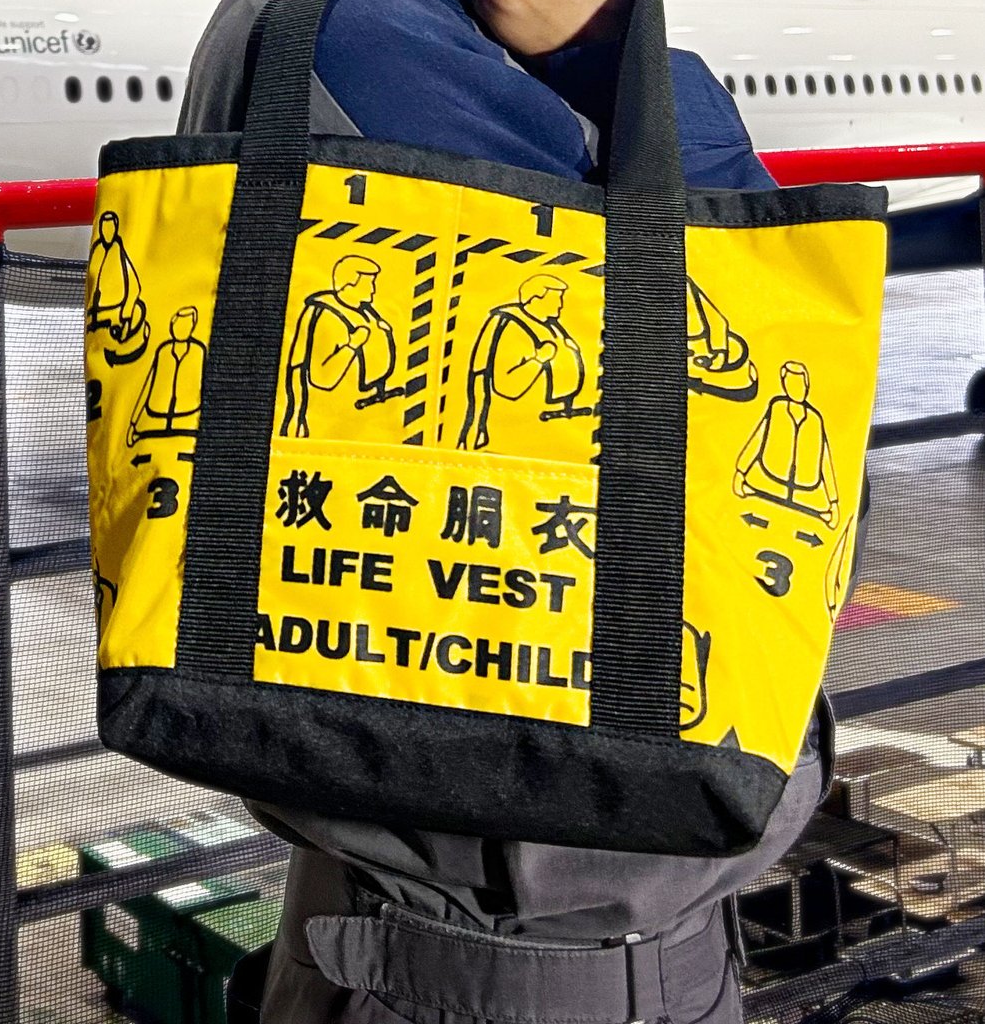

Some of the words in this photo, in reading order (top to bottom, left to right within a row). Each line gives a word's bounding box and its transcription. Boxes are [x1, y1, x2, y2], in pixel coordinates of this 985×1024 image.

[345, 174, 367, 206] 1
[530, 204, 554, 238] 1
[146, 477, 179, 519] 3
[275, 470, 595, 560] 救命胴衣
[281, 545, 394, 592] LIFE
[427, 559, 576, 613] VEST
[754, 550, 794, 598] 3
